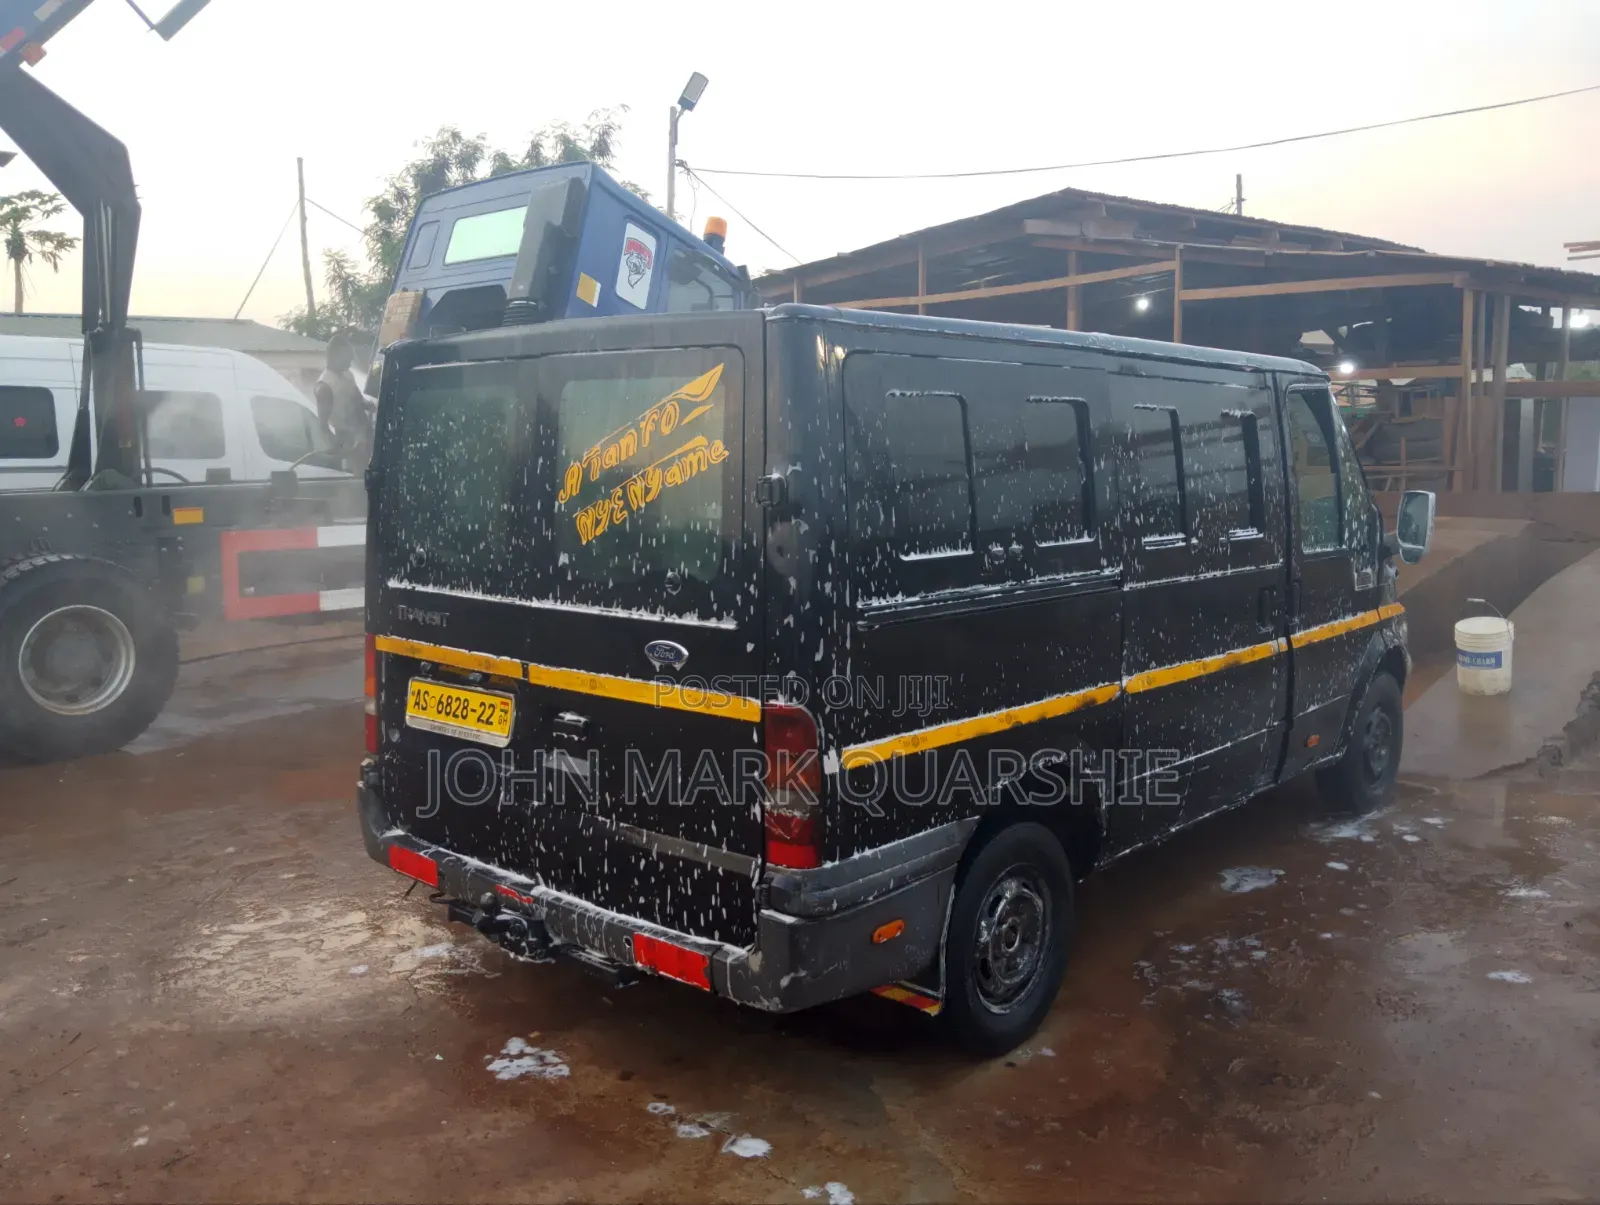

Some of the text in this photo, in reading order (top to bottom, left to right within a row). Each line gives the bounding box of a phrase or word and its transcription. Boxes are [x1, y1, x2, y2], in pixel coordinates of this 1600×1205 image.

[396, 604, 451, 628] TRANSIT
[653, 644, 677, 660] Ford
[412, 688, 496, 726] AS 6828-22
